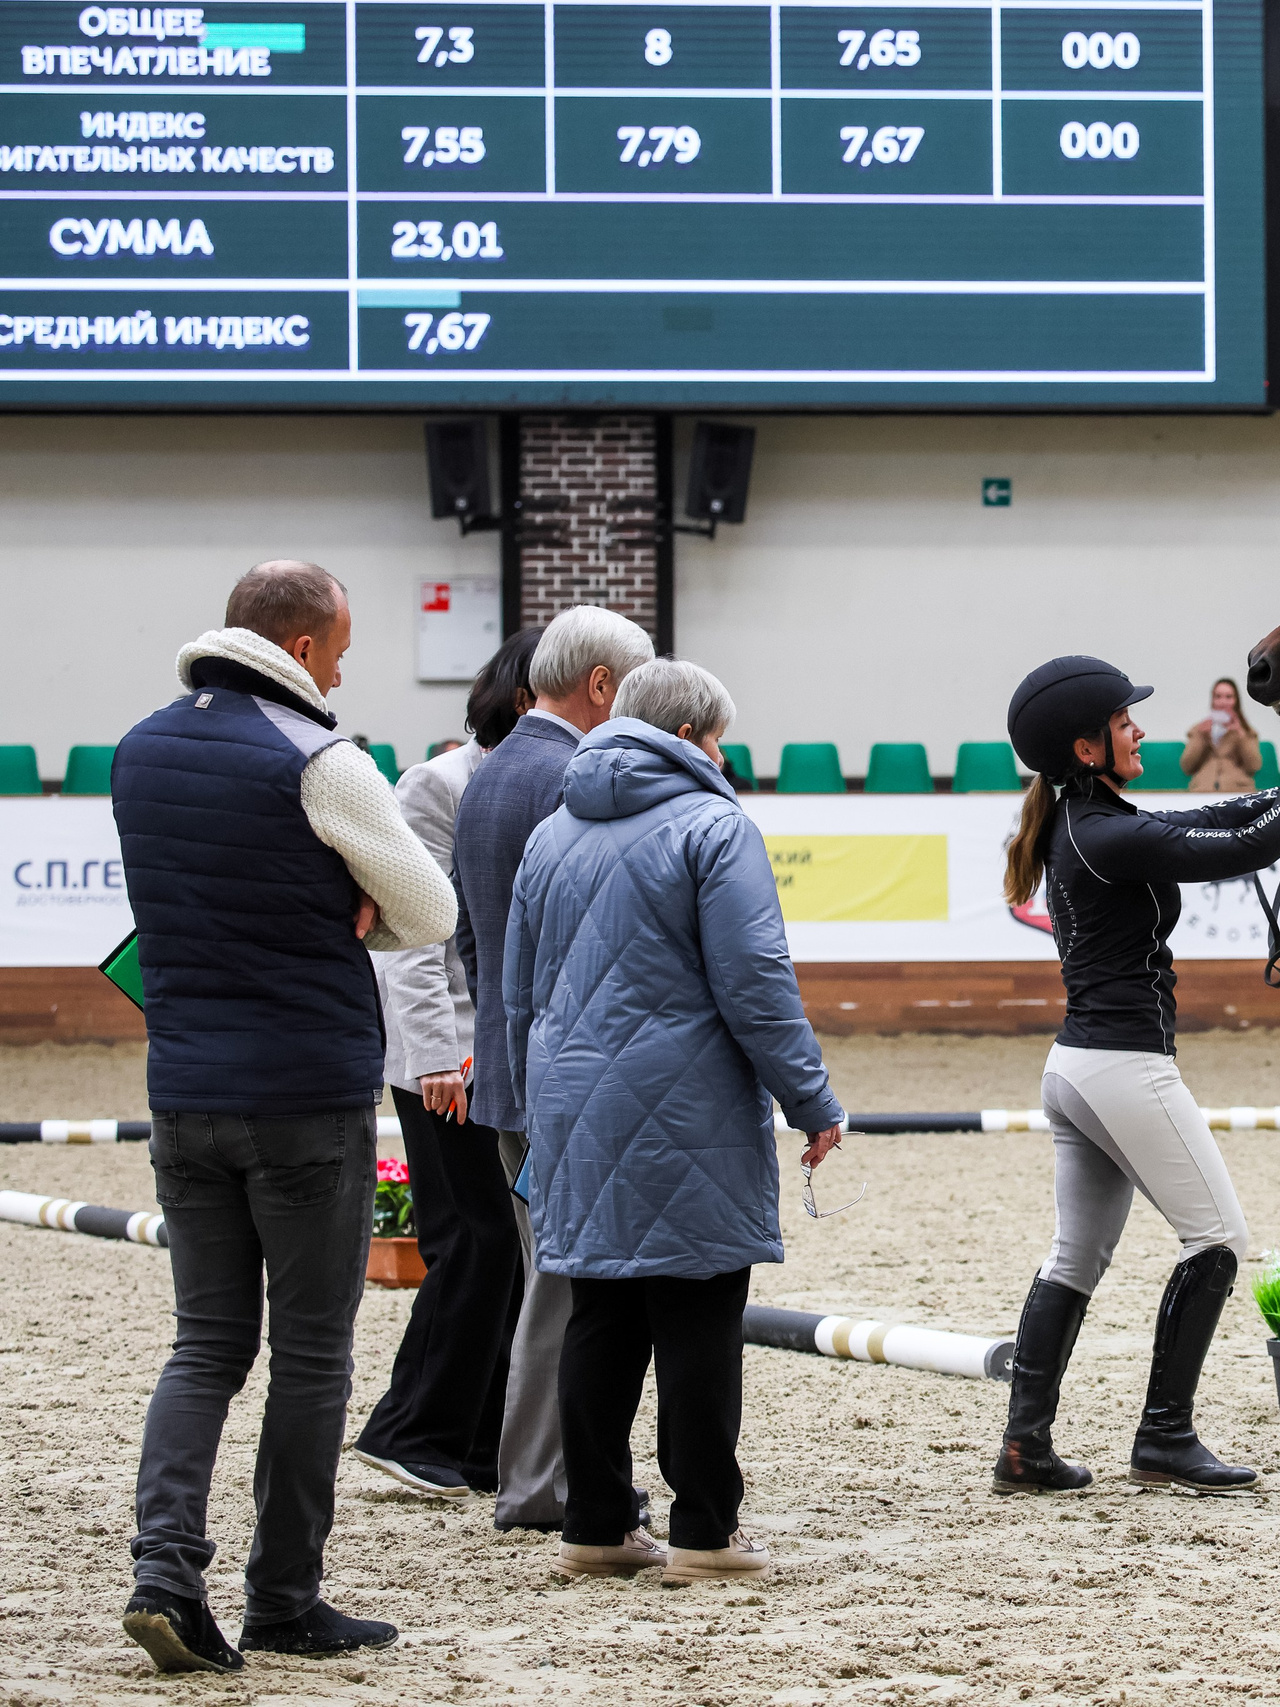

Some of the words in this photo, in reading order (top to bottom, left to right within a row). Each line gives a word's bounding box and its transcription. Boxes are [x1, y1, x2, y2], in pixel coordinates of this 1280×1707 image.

[79, 6, 206, 40] ОБЩЕЕ
[22, 45, 272, 76] ВПЕЧАТЛЕНИЕ
[415, 27, 475, 67] 7,3
[644, 29, 673, 66] 8
[837, 29, 922, 70] 7,65
[1062, 32, 1141, 70] 000
[80, 111, 206, 142] ИНДЕКС
[1059, 122, 1140, 159] 000
[0, 145, 196, 173] ИГАТЕЛЬНЫХ
[201, 146, 335, 174] КАЧЕСТВ
[401, 126, 486, 168] 7,55
[617, 126, 702, 167] 7,79
[840, 126, 925, 167] 7,67
[49, 218, 215, 256] СУММА
[391, 221, 504, 261] 23,01
[163, 314, 310, 350] ИНДЕКС
[404, 313, 491, 355] 7,67
[1185, 827, 1233, 839] horses
